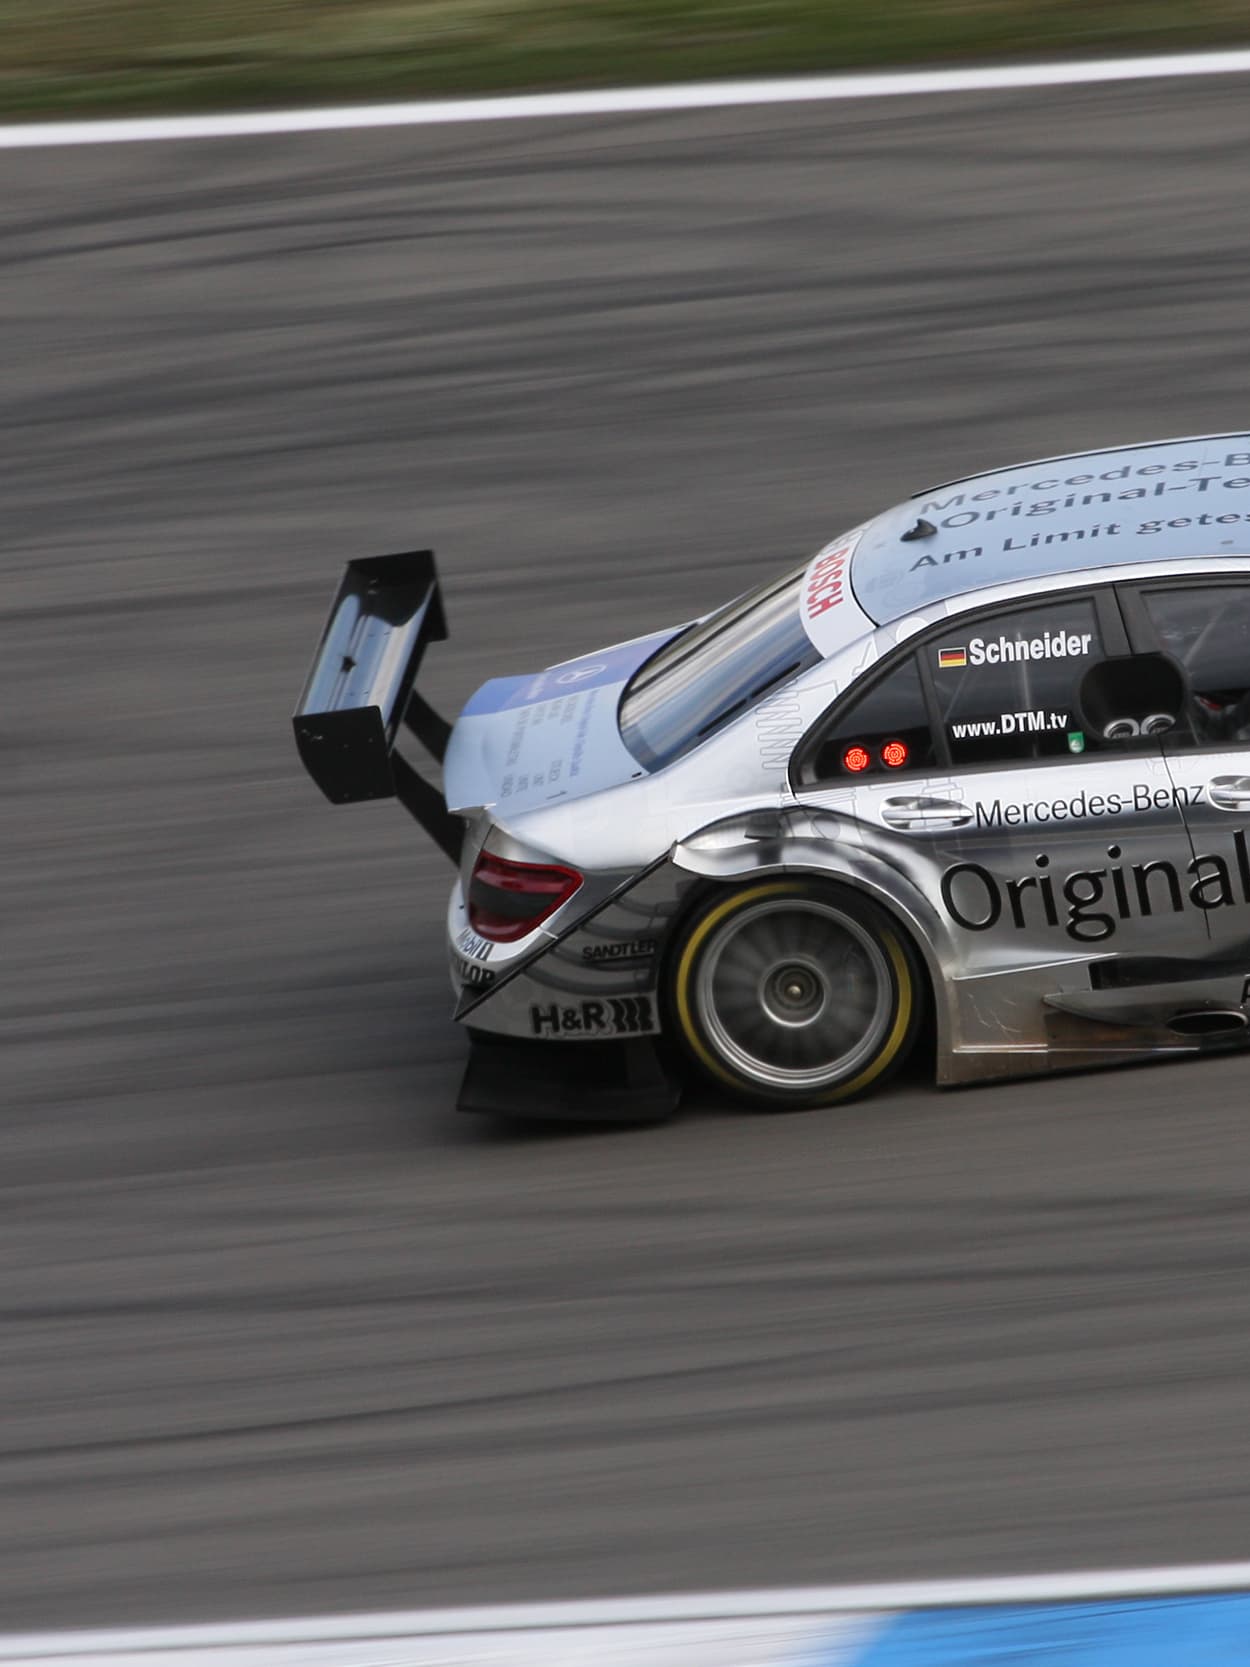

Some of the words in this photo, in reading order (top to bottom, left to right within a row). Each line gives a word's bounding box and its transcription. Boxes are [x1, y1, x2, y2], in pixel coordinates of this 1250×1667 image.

[909, 546, 983, 572] Am
[1003, 524, 1121, 552] Limit
[807, 547, 849, 619] BOSCH
[969, 631, 1092, 665] Schneider
[953, 711, 1068, 738] www.DTM.tv
[976, 784, 1206, 828] Mercedes-Benz
[531, 1001, 607, 1035] H&R
